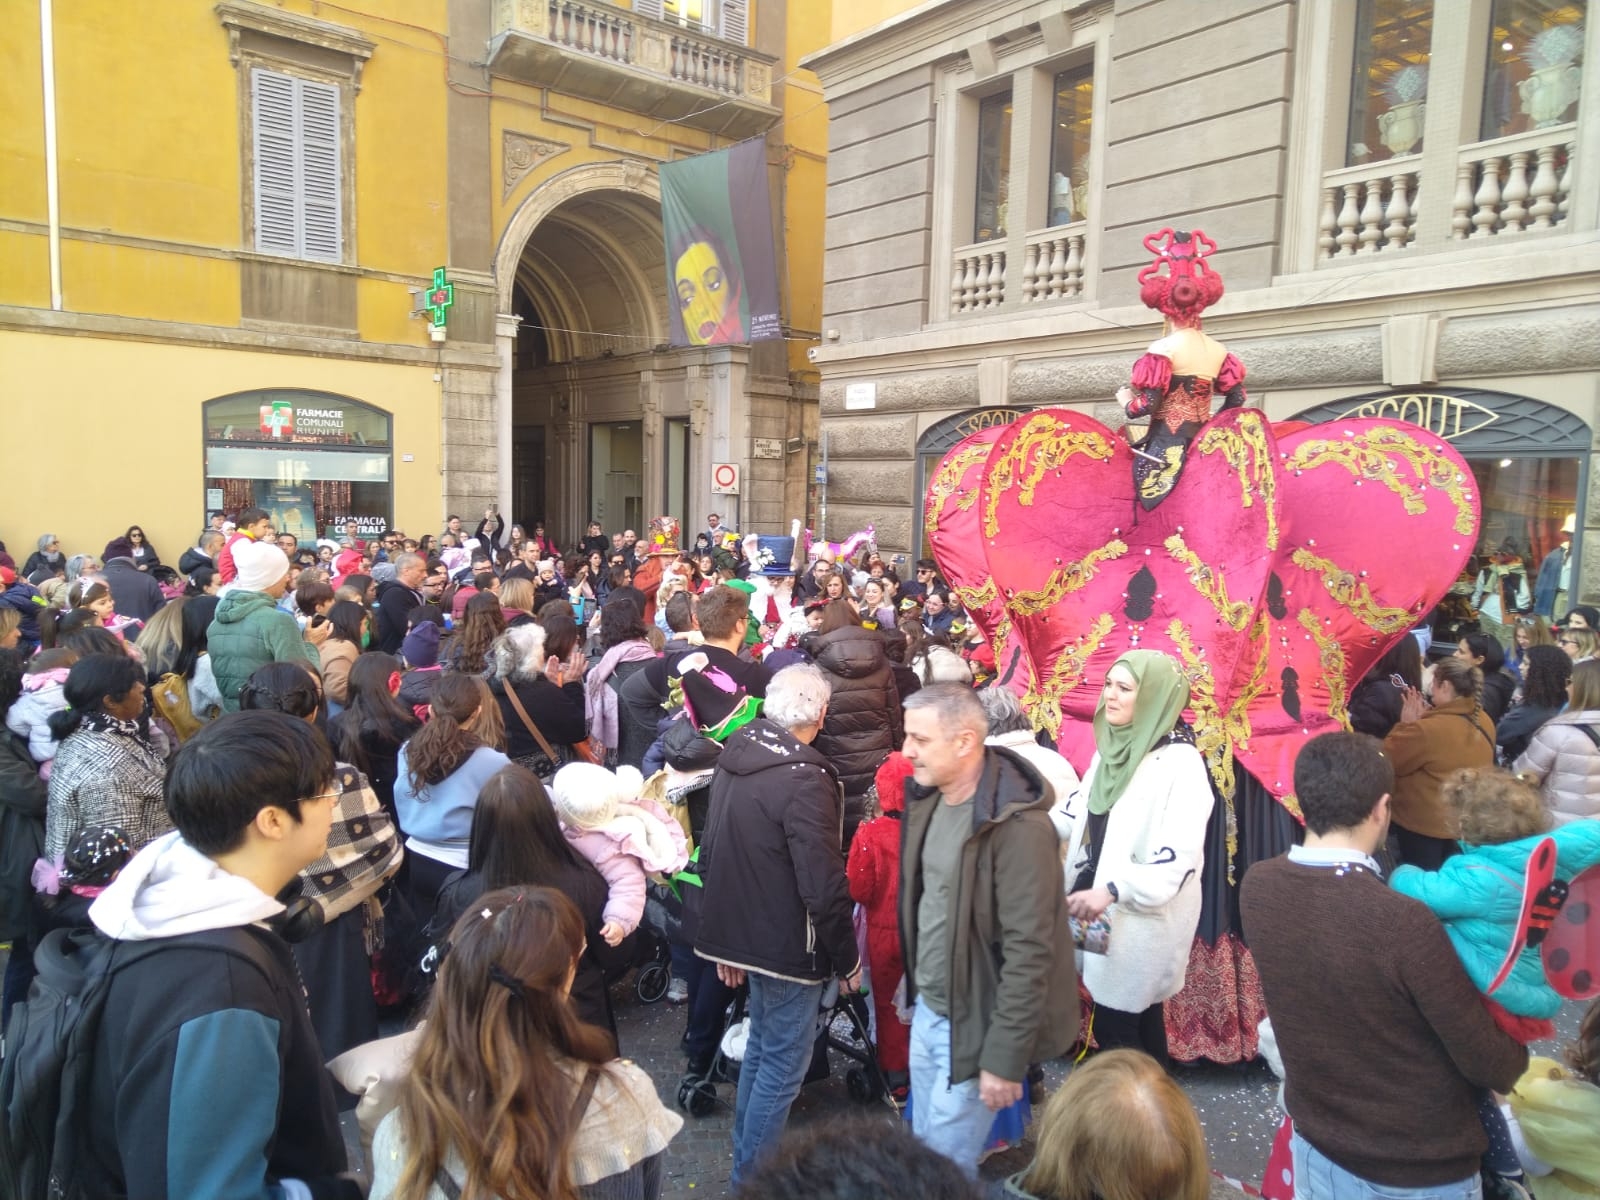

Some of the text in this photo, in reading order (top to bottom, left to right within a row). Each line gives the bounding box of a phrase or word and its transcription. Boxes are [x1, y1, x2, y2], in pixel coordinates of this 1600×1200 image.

[297, 408, 344, 419] FARMACIE
[296, 417, 344, 428] COMUNALI
[296, 427, 344, 437] RIUNITE
[335, 525, 387, 534] CETRALE
